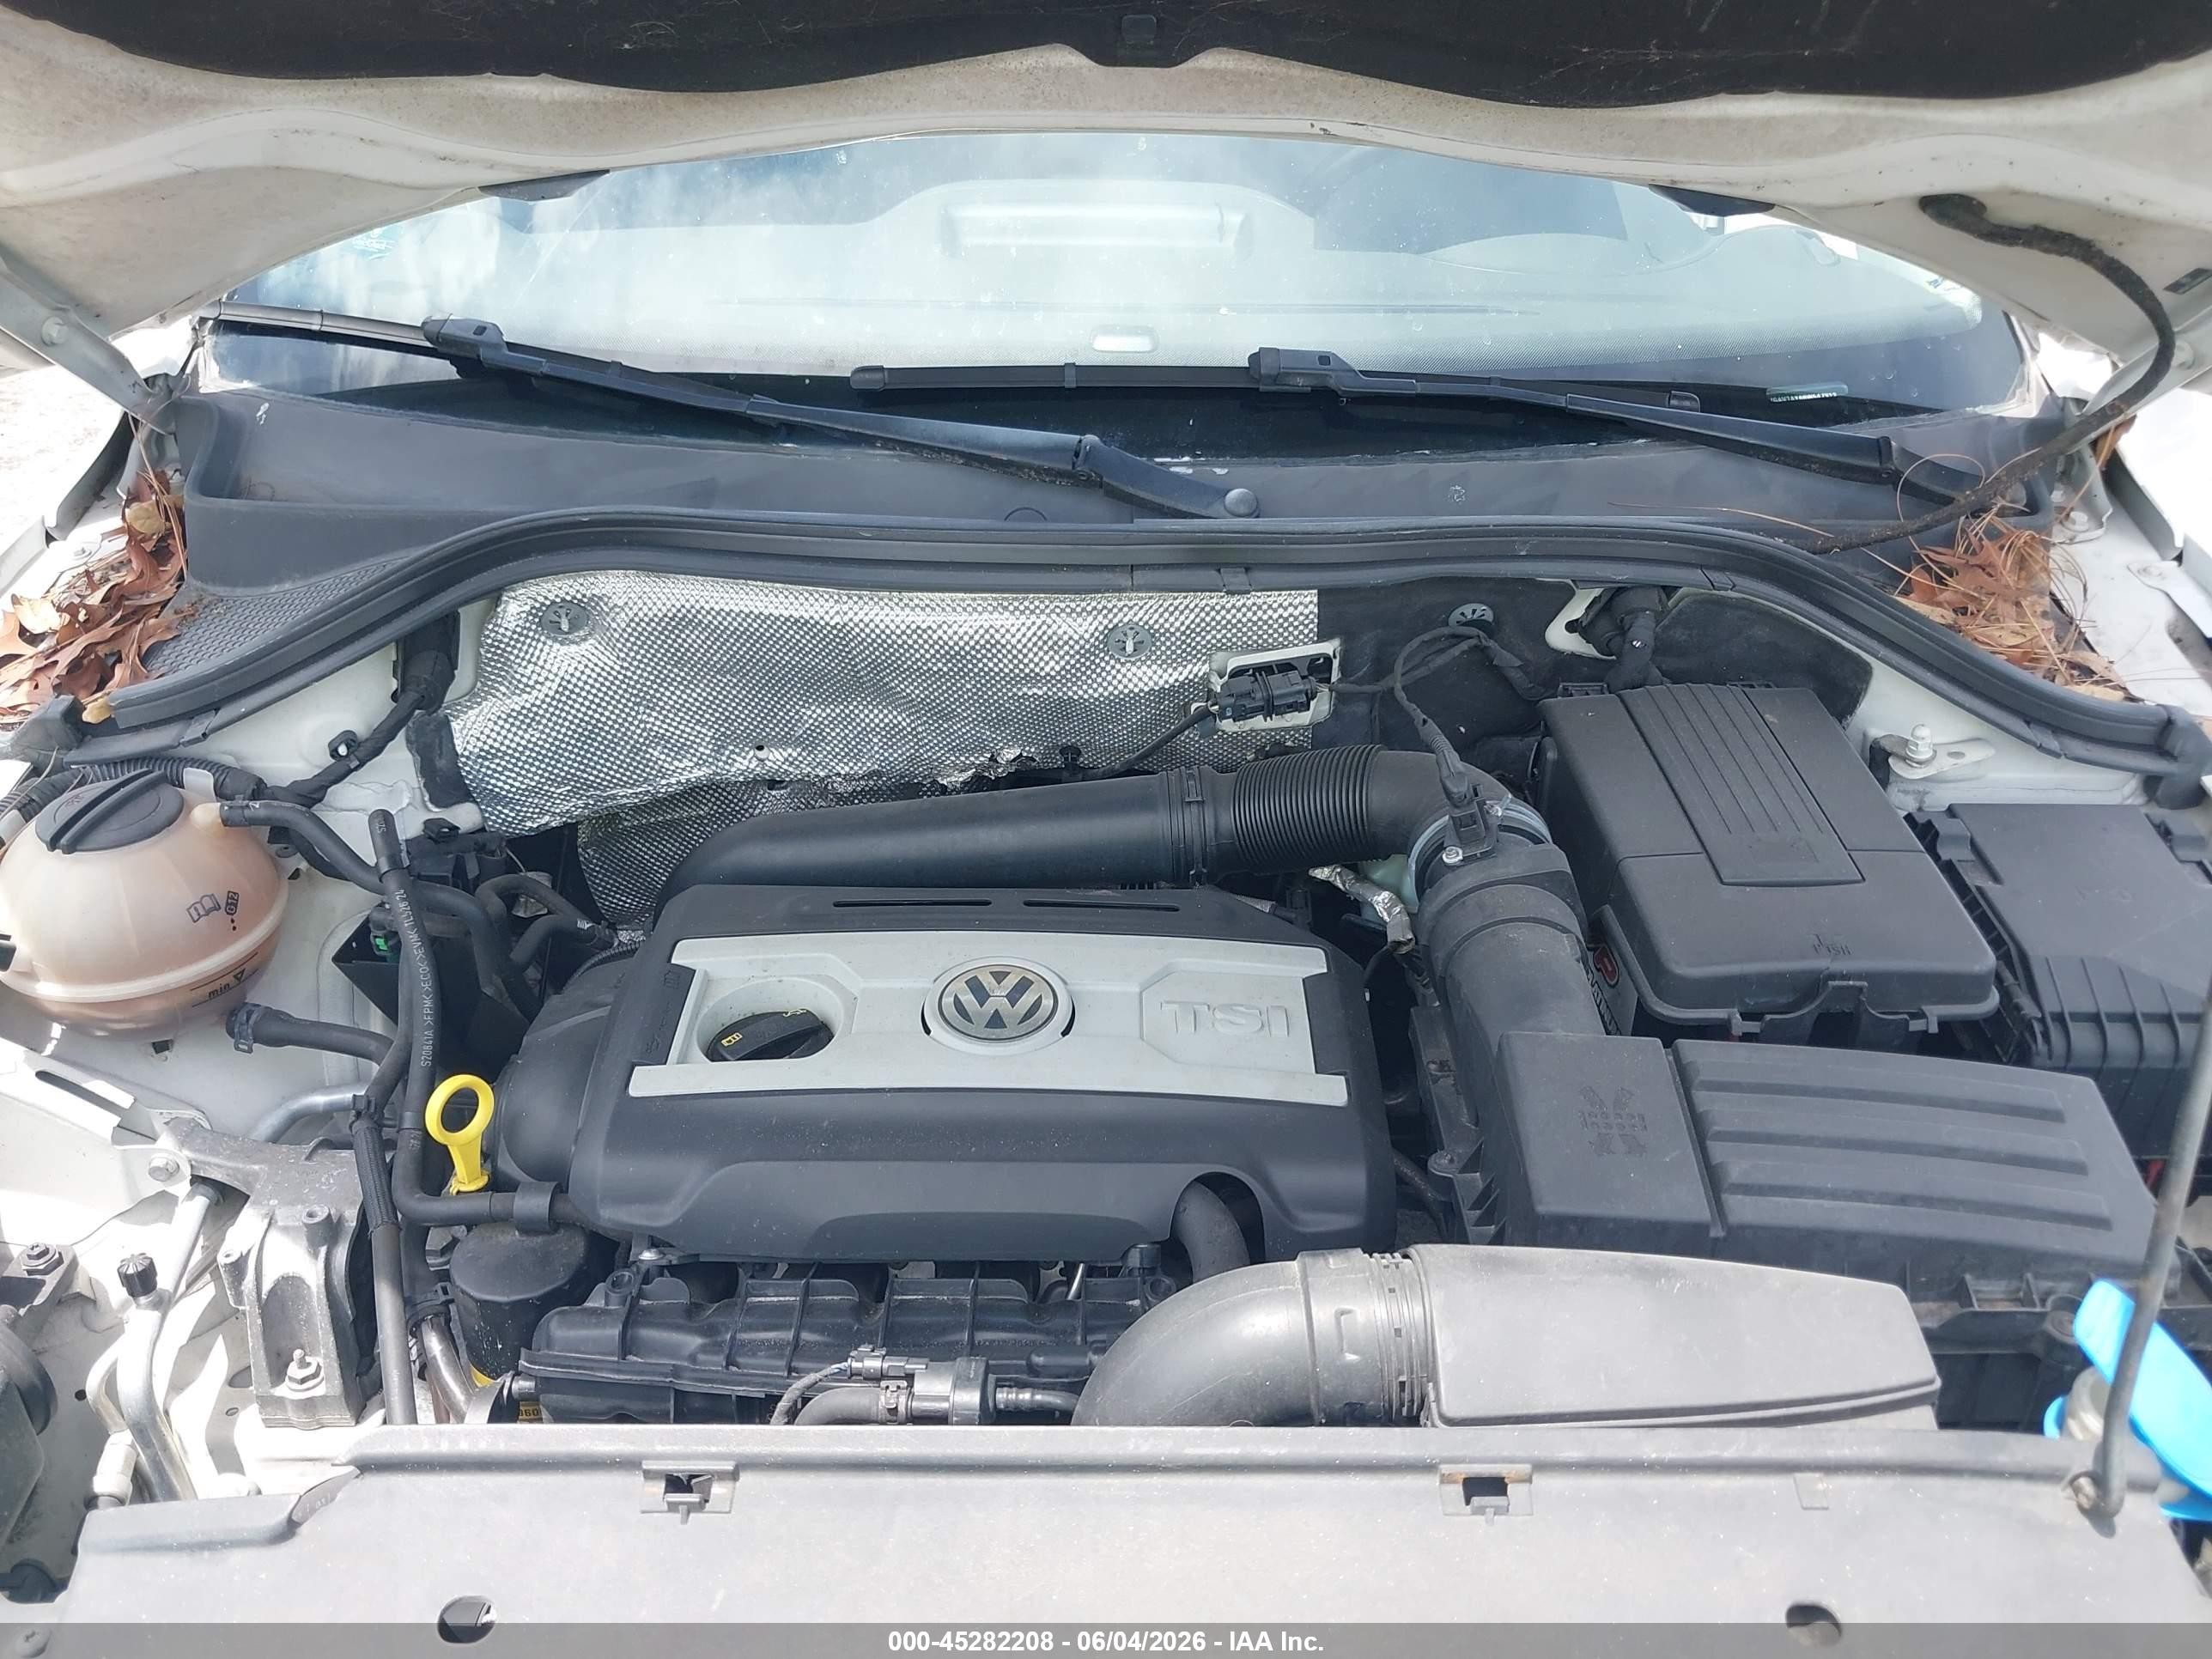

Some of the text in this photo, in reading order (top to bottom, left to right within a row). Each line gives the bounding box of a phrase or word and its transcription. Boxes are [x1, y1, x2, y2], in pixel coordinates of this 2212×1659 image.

[208, 982, 231, 1000] min
[938, 964, 1059, 1042] VW
[1160, 1000, 1290, 1037] TSI
